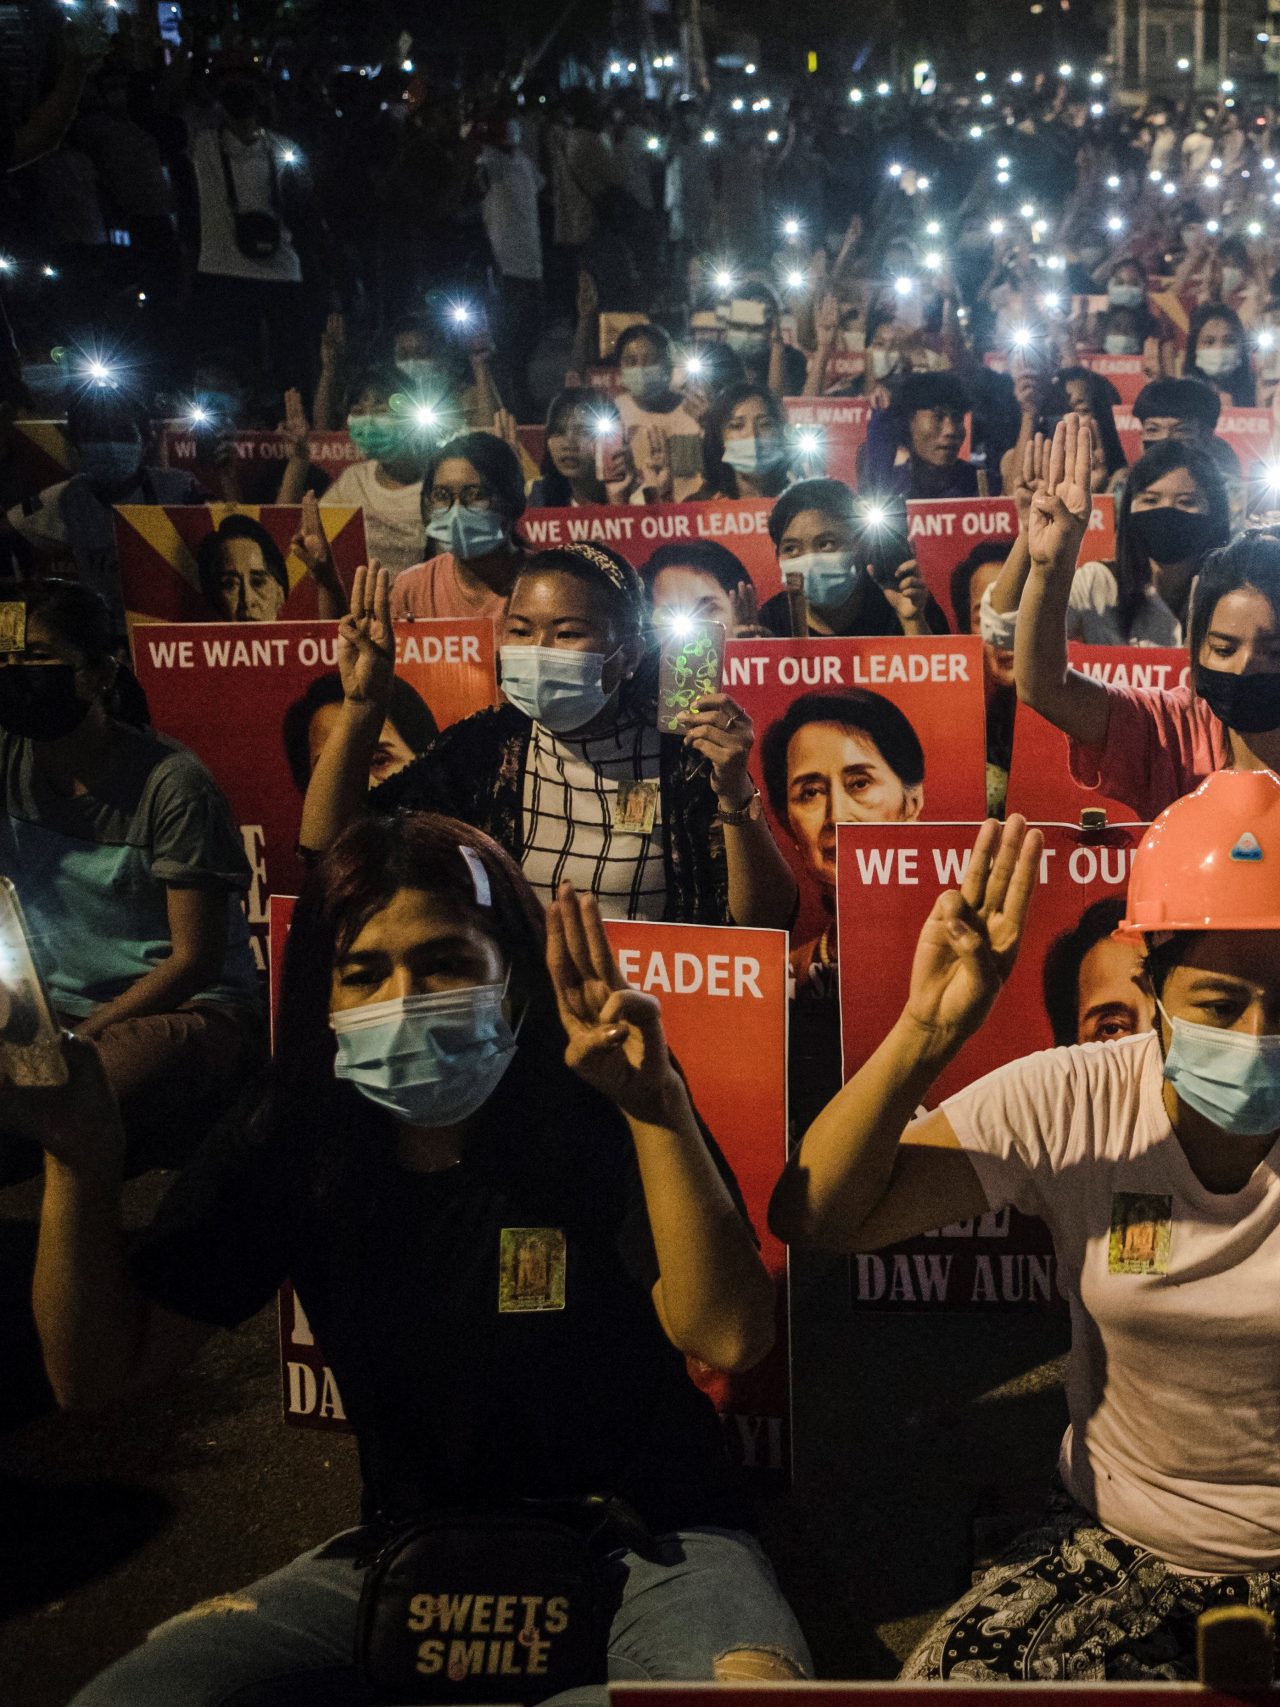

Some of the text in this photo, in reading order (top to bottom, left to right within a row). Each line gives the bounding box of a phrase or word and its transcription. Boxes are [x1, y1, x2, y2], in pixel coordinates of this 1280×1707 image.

[1215, 416, 1271, 433] EADER
[524, 510, 770, 543] WE WANT OUR LEADE
[908, 511, 1012, 536] ANT OUR
[148, 640, 195, 669] WE
[202, 638, 290, 668] WANT
[298, 637, 339, 666] OU
[777, 656, 845, 686] OUR
[852, 653, 970, 683] LEADER
[1083, 662, 1172, 689] WANT
[855, 847, 1136, 885] WE WT OU
[618, 949, 764, 999] EADER
[855, 1253, 1053, 1302] DAW AUN
[286, 1361, 347, 1420] DA
[730, 1411, 785, 1470] YI
[405, 1592, 572, 1634] SWEETS
[414, 1637, 551, 1679] SMILE
